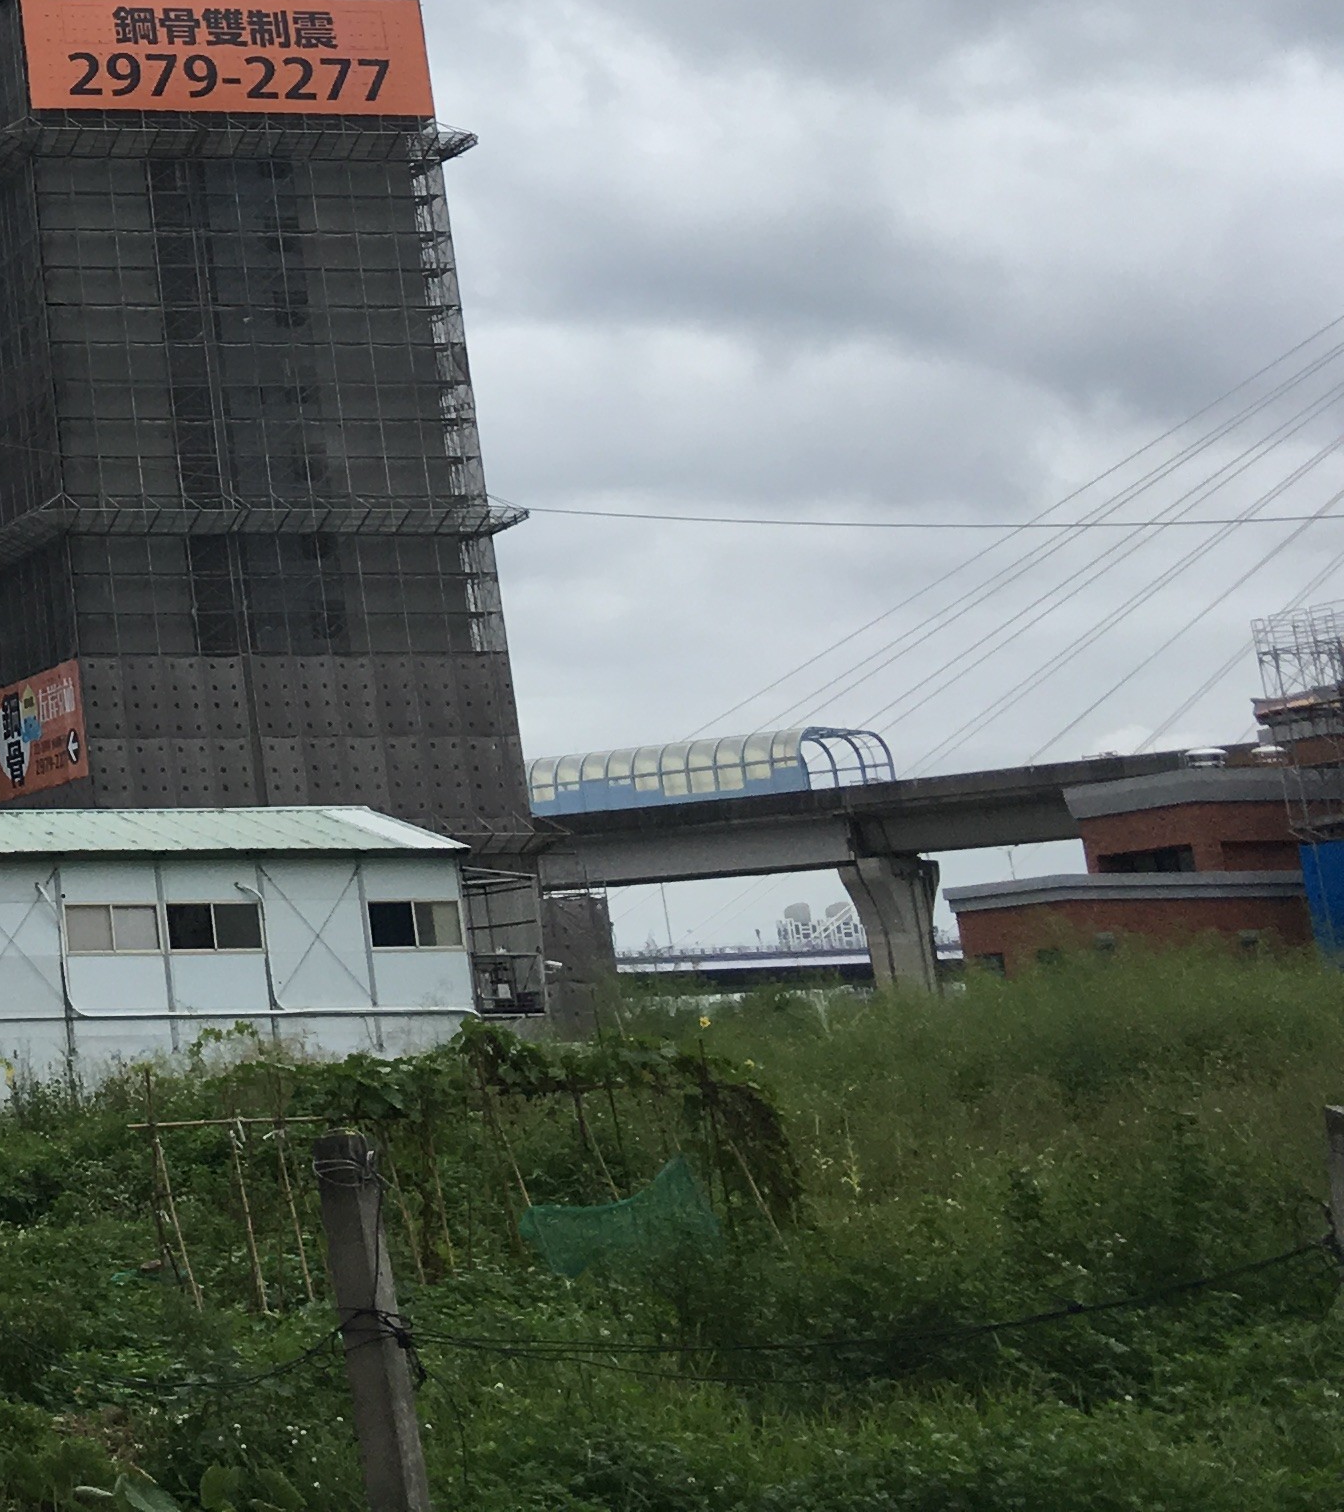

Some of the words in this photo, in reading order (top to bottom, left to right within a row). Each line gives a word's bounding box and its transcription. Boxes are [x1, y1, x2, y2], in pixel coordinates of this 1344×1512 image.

[112, 6, 339, 50] 鋼骨雙制震
[68, 52, 390, 103] 2979-2277
